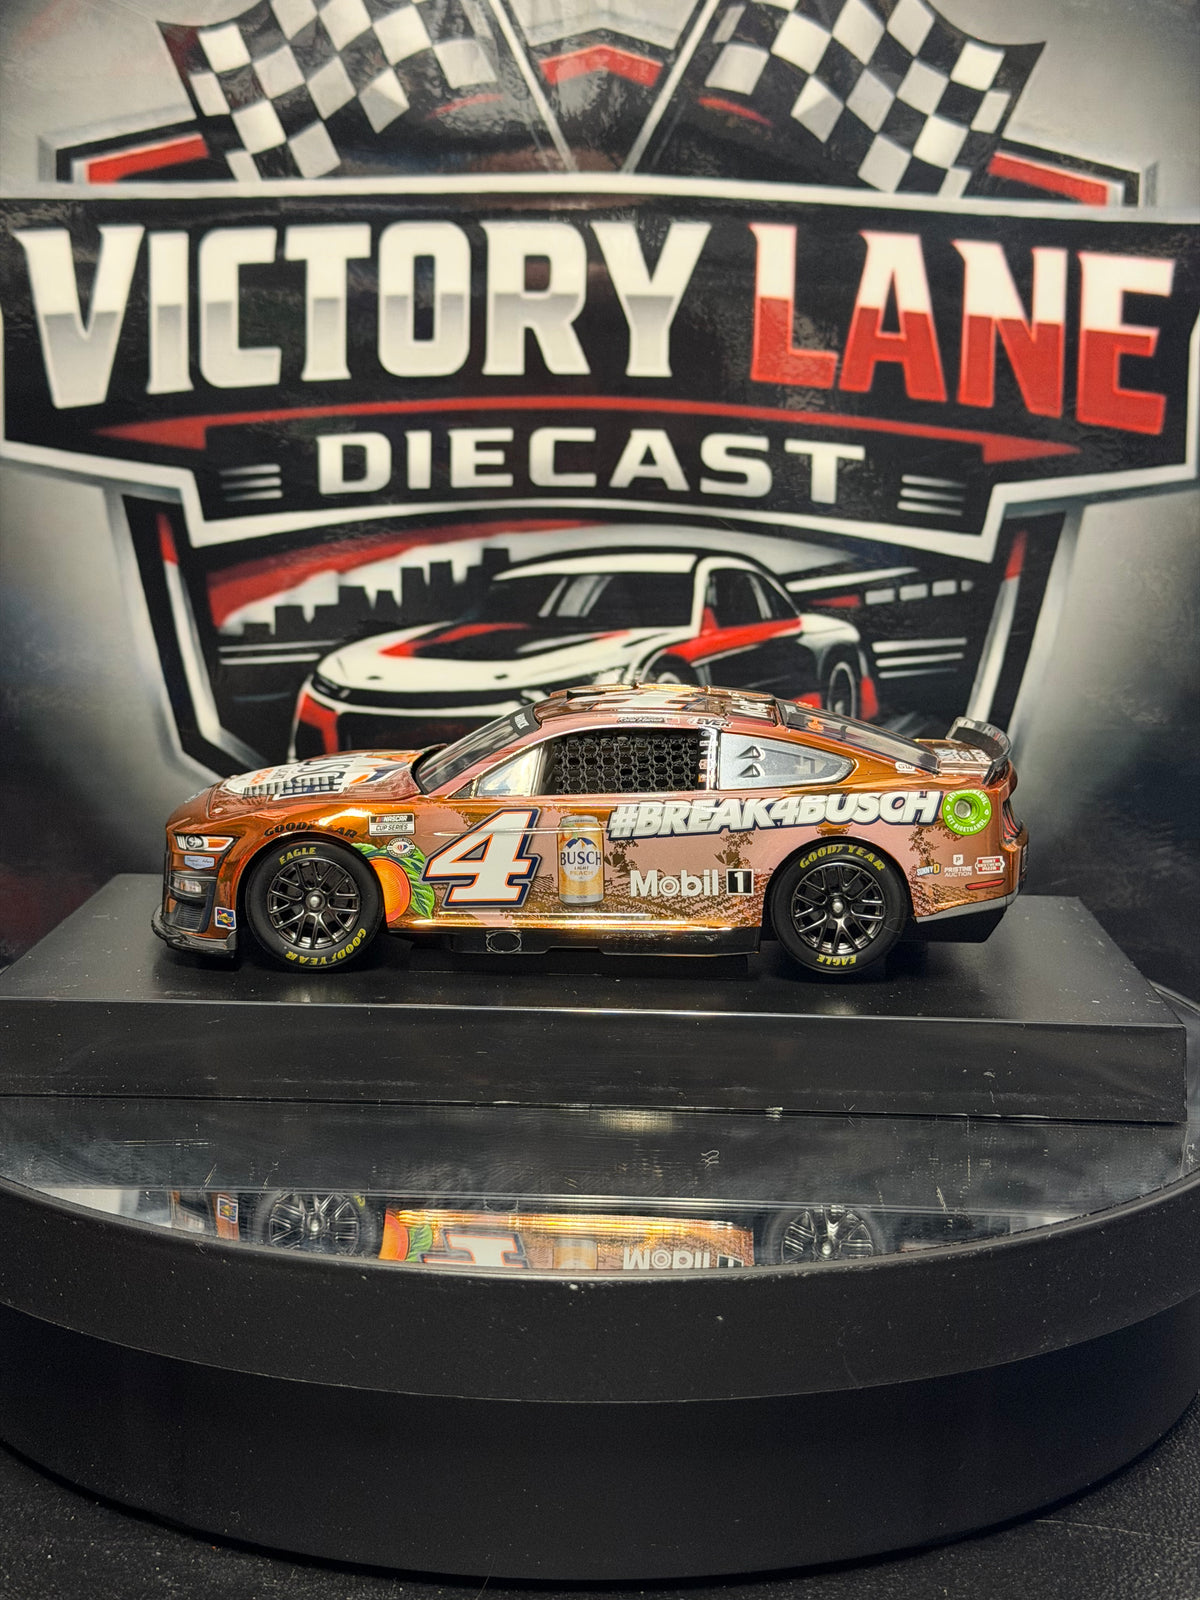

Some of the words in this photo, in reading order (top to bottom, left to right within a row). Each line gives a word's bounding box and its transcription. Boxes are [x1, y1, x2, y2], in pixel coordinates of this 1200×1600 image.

[12, 221, 711, 409] VICTORY
[749, 223, 1176, 435] LANE
[317, 427, 866, 504] DIECAST
[383, 815, 408, 823] NASCAR
[608, 791, 943, 840] #BREAK4BUSCH
[279, 847, 317, 865] EAGLE
[421, 808, 541, 907] 4
[560, 851, 602, 866] BUSCH
[630, 869, 719, 897] Mobil
[816, 954, 857, 966] EAGLE
